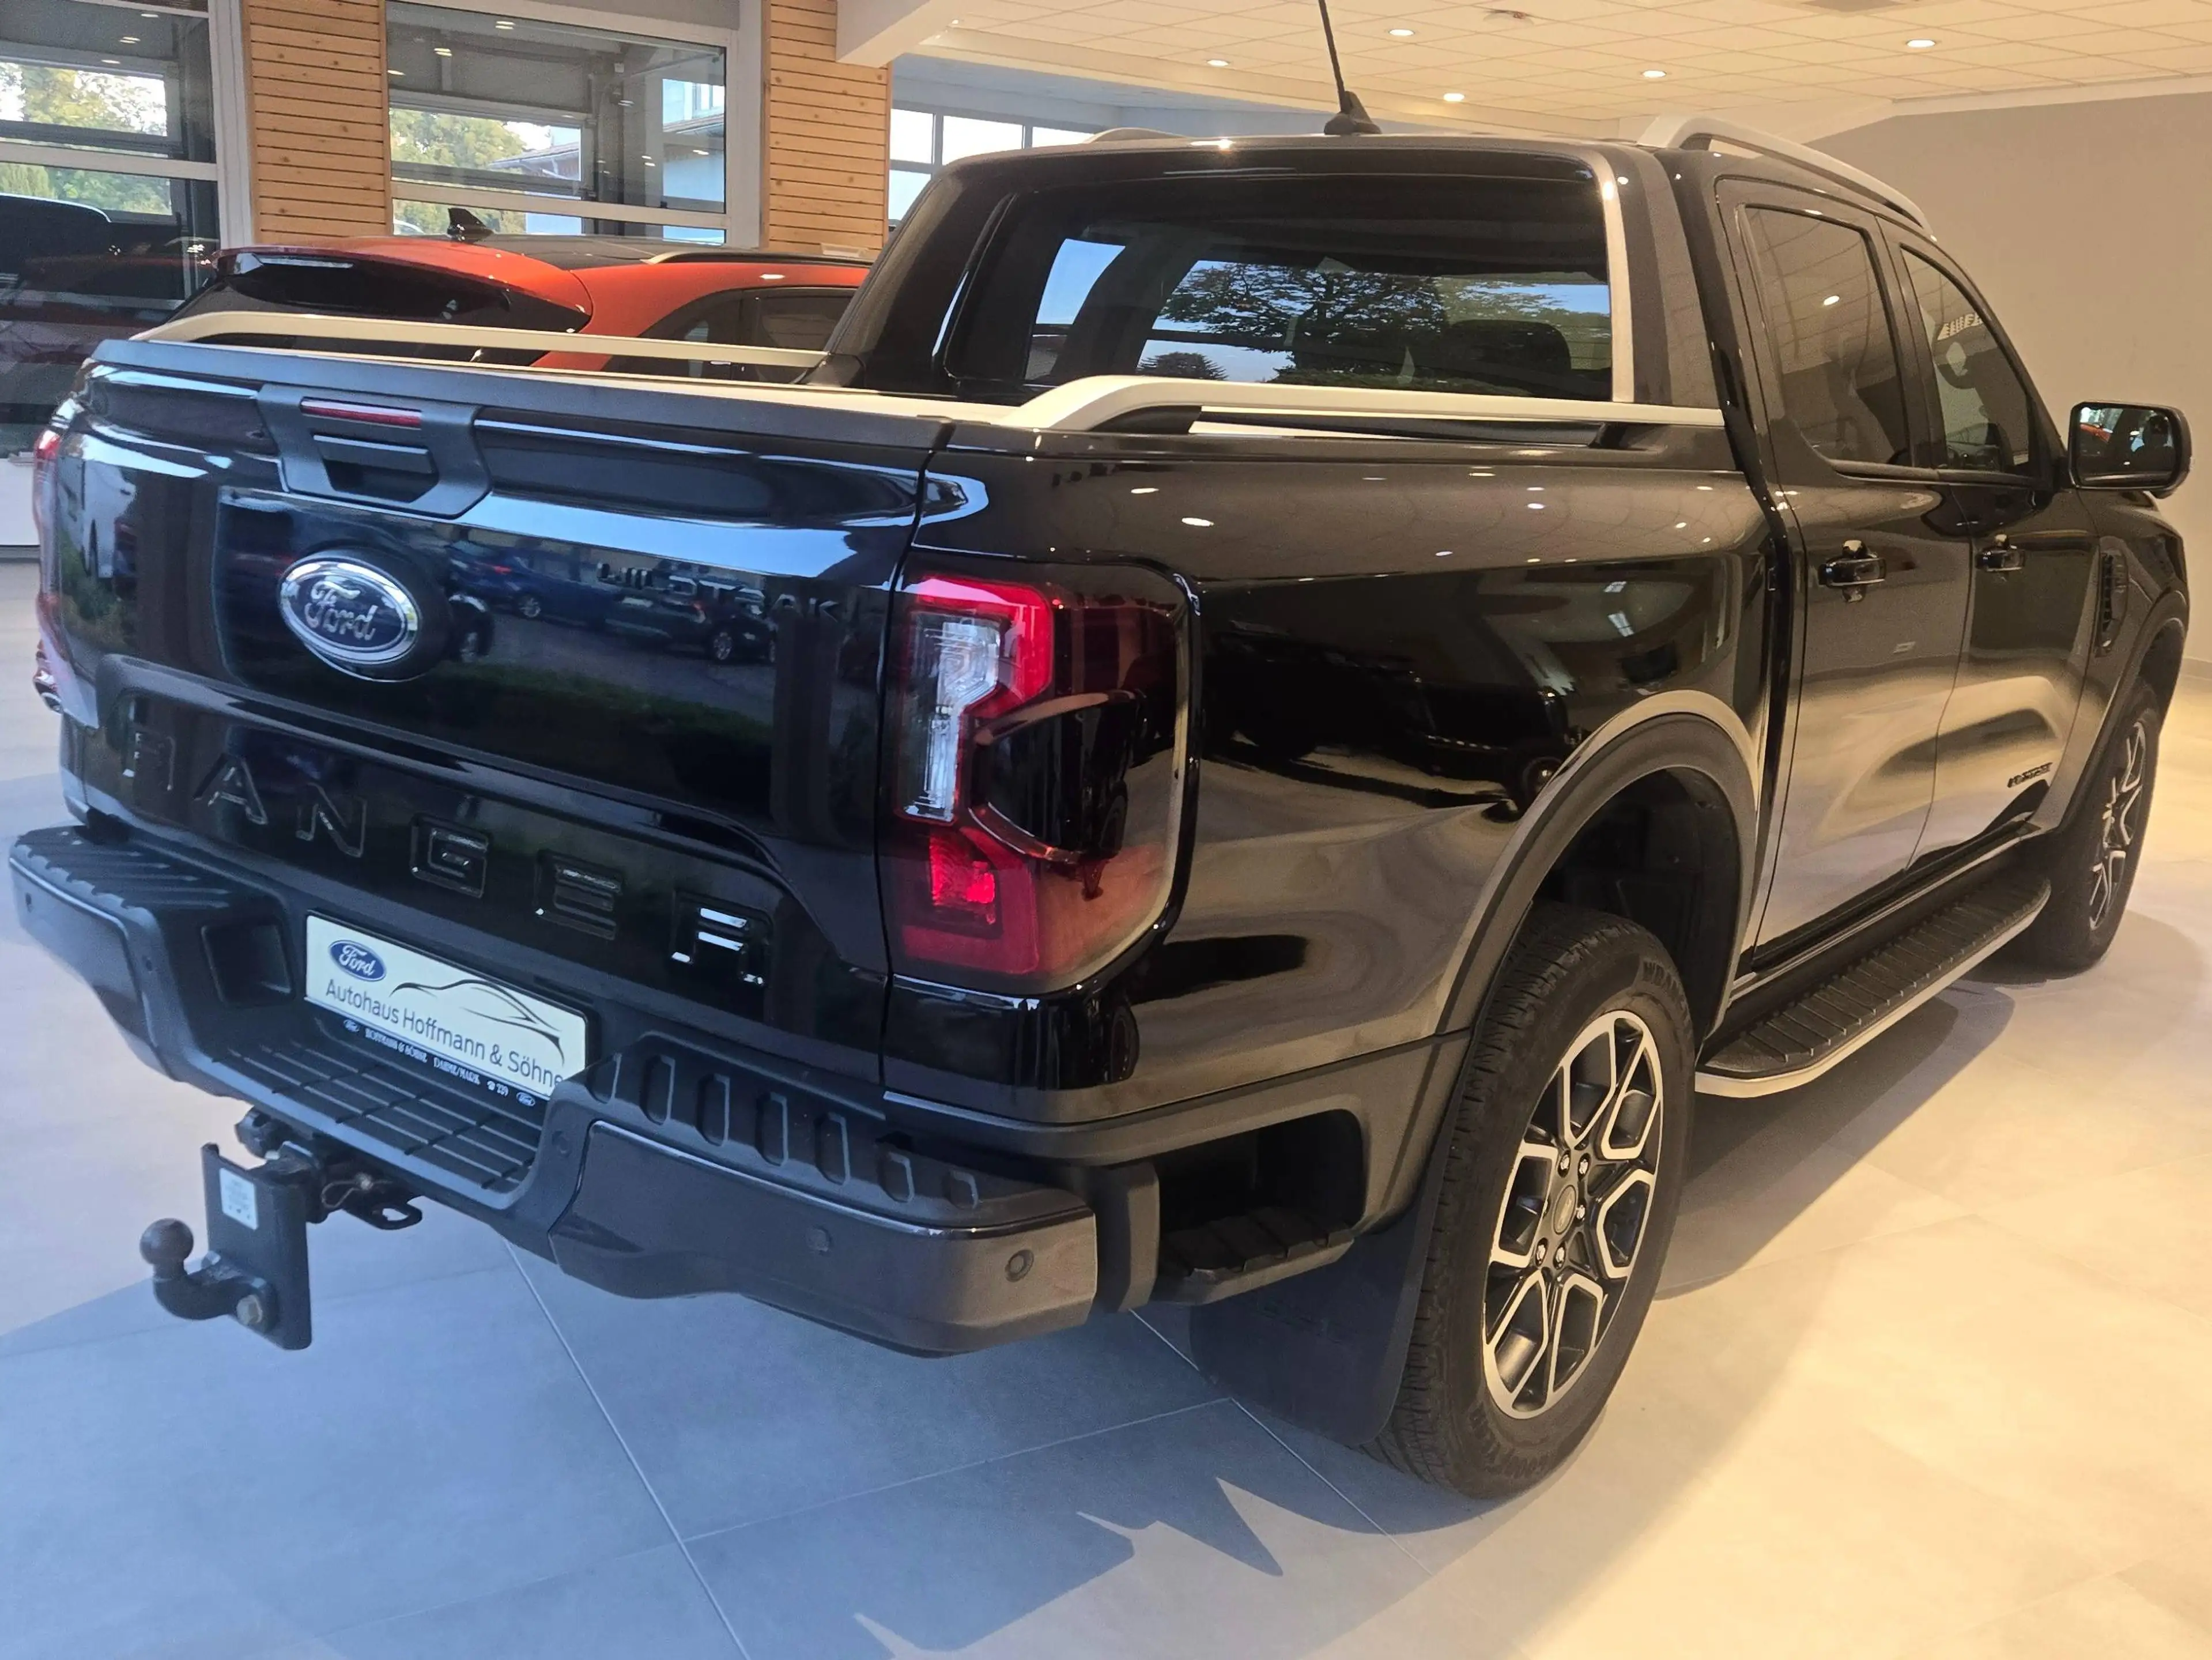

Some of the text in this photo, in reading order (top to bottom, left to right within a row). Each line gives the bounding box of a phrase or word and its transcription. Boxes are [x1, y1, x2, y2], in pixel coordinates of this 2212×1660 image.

[304, 580, 378, 641] Ford
[338, 945, 375, 977] Ford
[326, 979, 399, 1024] Autohaus
[403, 1008, 485, 1060] Hoffmann
[490, 1044, 503, 1066] &
